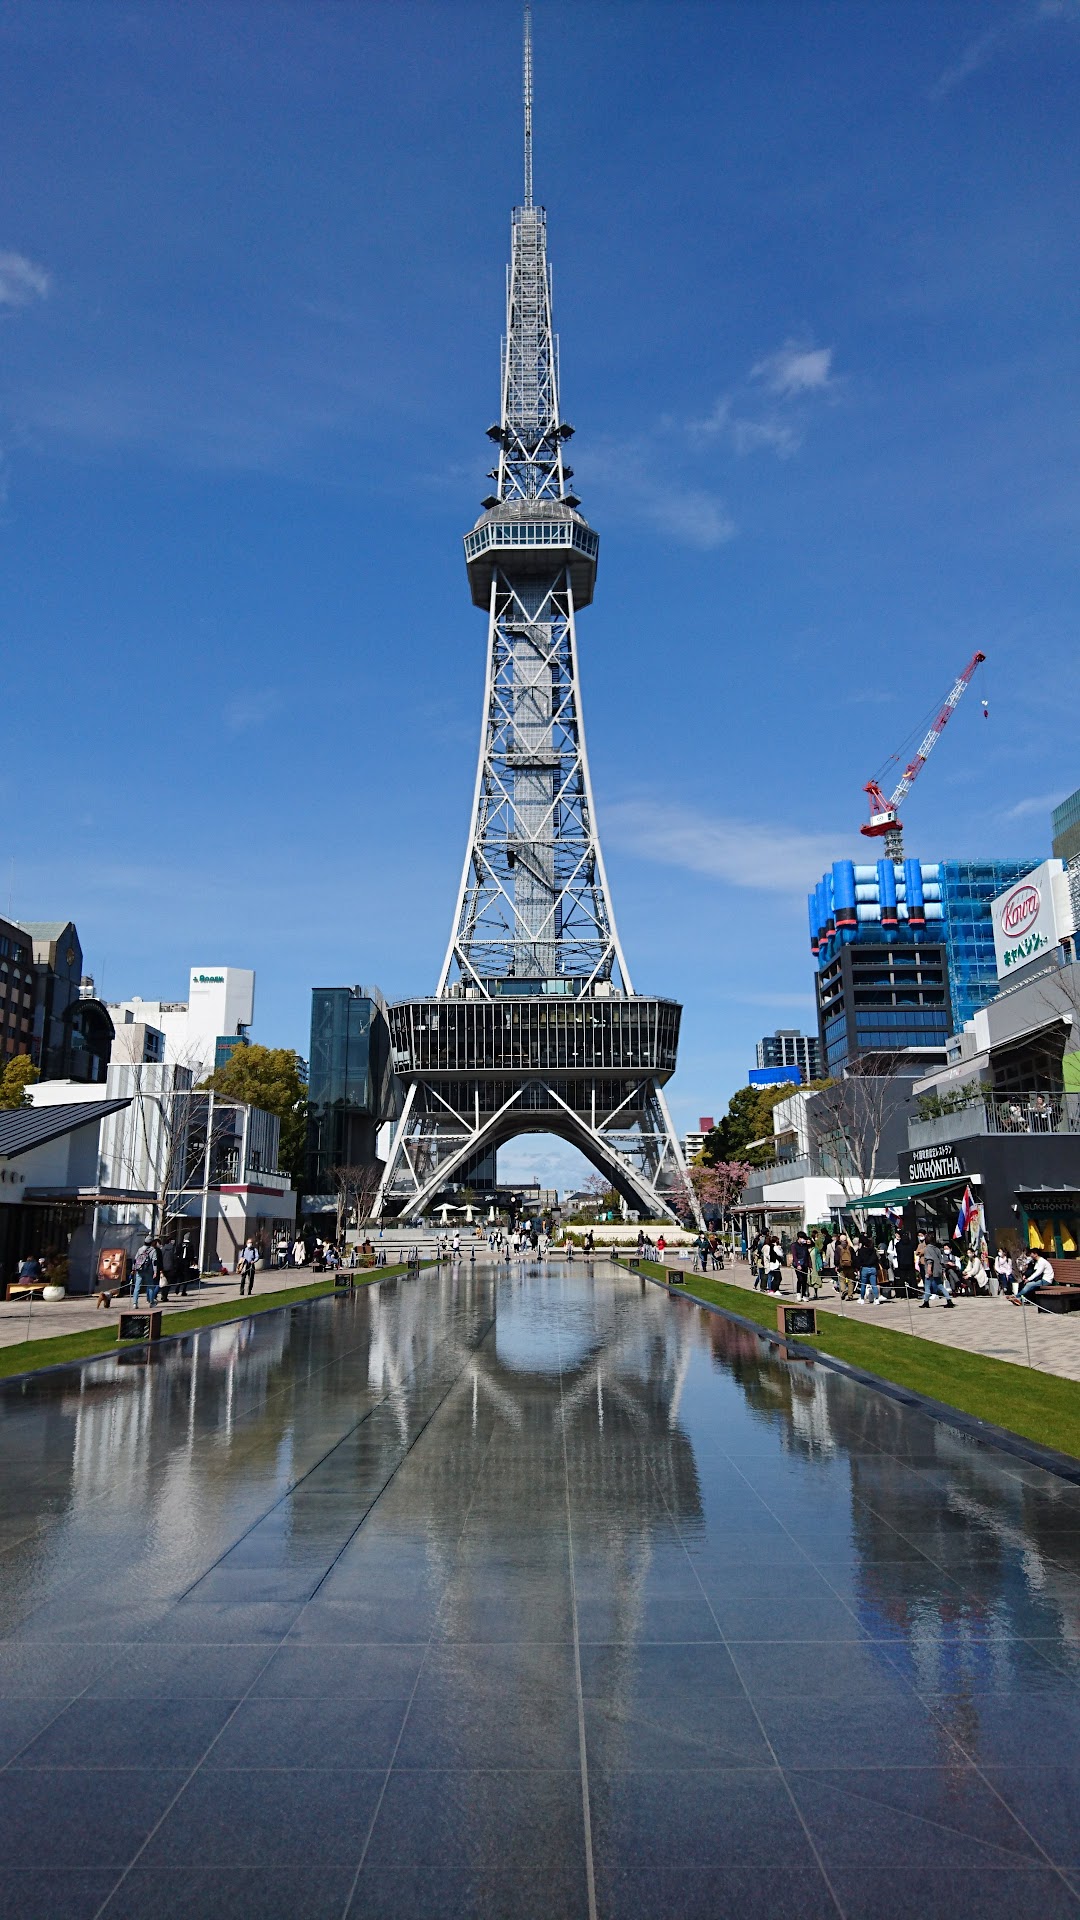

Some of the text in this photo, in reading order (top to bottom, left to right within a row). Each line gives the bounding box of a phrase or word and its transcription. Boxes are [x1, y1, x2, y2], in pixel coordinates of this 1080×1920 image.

[1005, 894, 1039, 930] Kowa
[751, 1079, 795, 1090] Panao
[909, 1157, 961, 1180] SUKHONTHA
